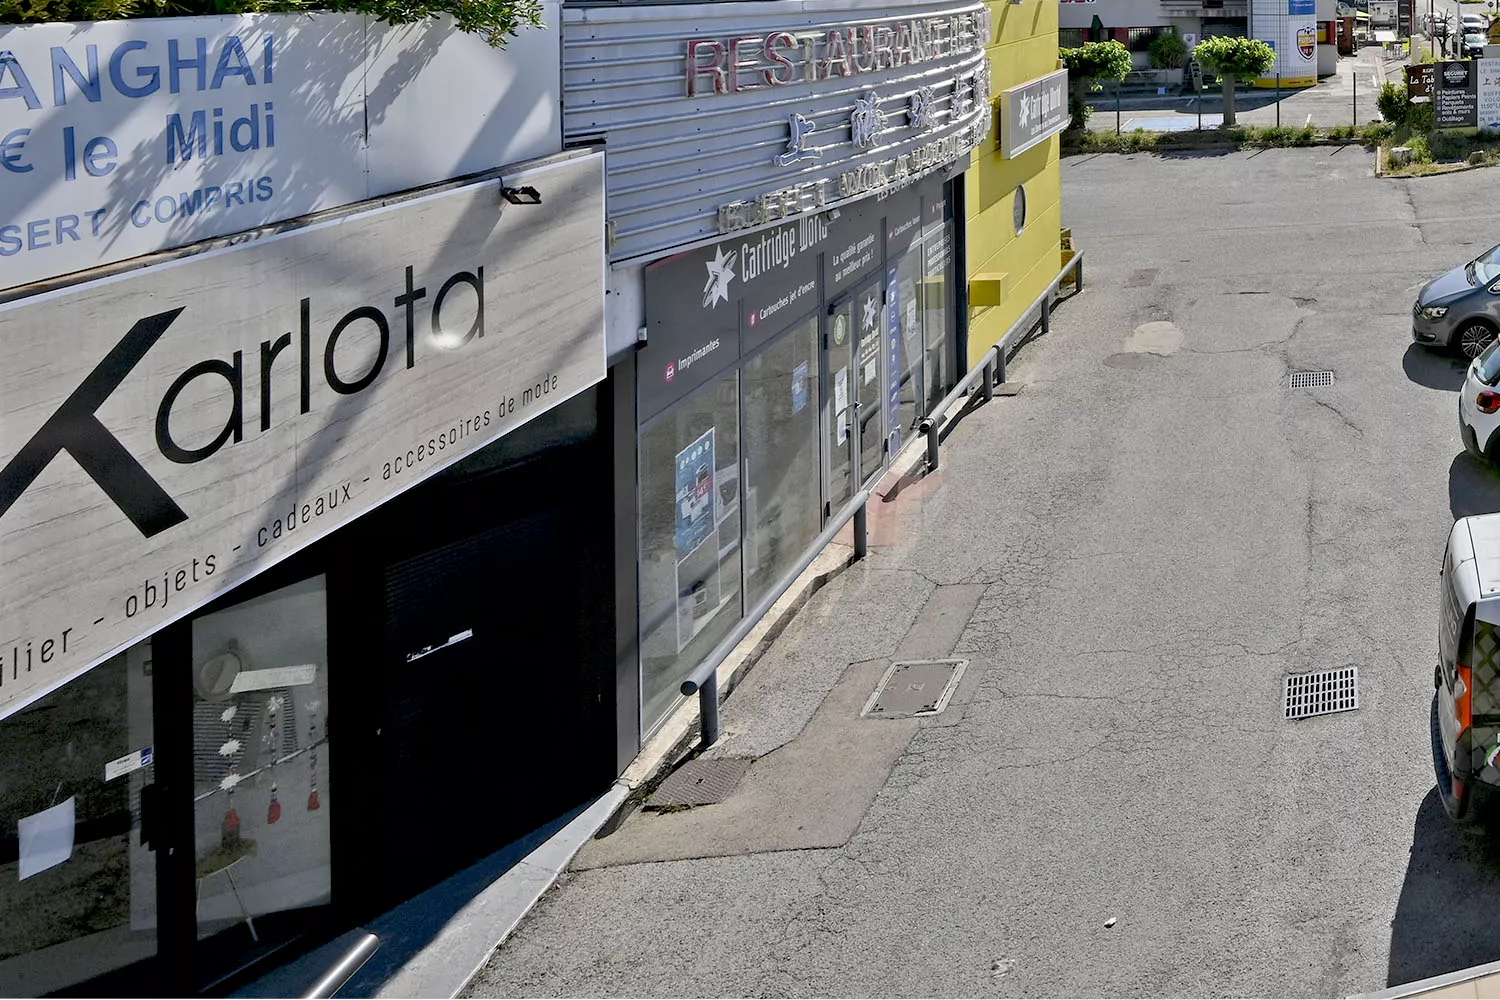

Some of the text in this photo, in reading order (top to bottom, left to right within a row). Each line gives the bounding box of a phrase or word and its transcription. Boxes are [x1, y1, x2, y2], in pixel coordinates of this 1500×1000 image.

[0, 34, 274, 110] ANGHAI
[686, 18, 944, 98] RESTAURANT
[1410, 75, 1435, 84] La Tab
[64, 126, 118, 181] le
[166, 101, 275, 165] Midi
[0, 176, 274, 257] SERT COMPRIS
[741, 225, 796, 283] Cartridge
[759, 295, 788, 320] Cartouches
[798, 280, 815, 300] d'encre
[677, 336, 720, 371] Imprimantes
[0, 265, 485, 539] Karlota
[125, 551, 217, 620] objets
[257, 482, 351, 549] cadeaux
[383, 411, 491, 482] accessoires
[499, 395, 516, 419] de
[522, 373, 559, 406] mode
